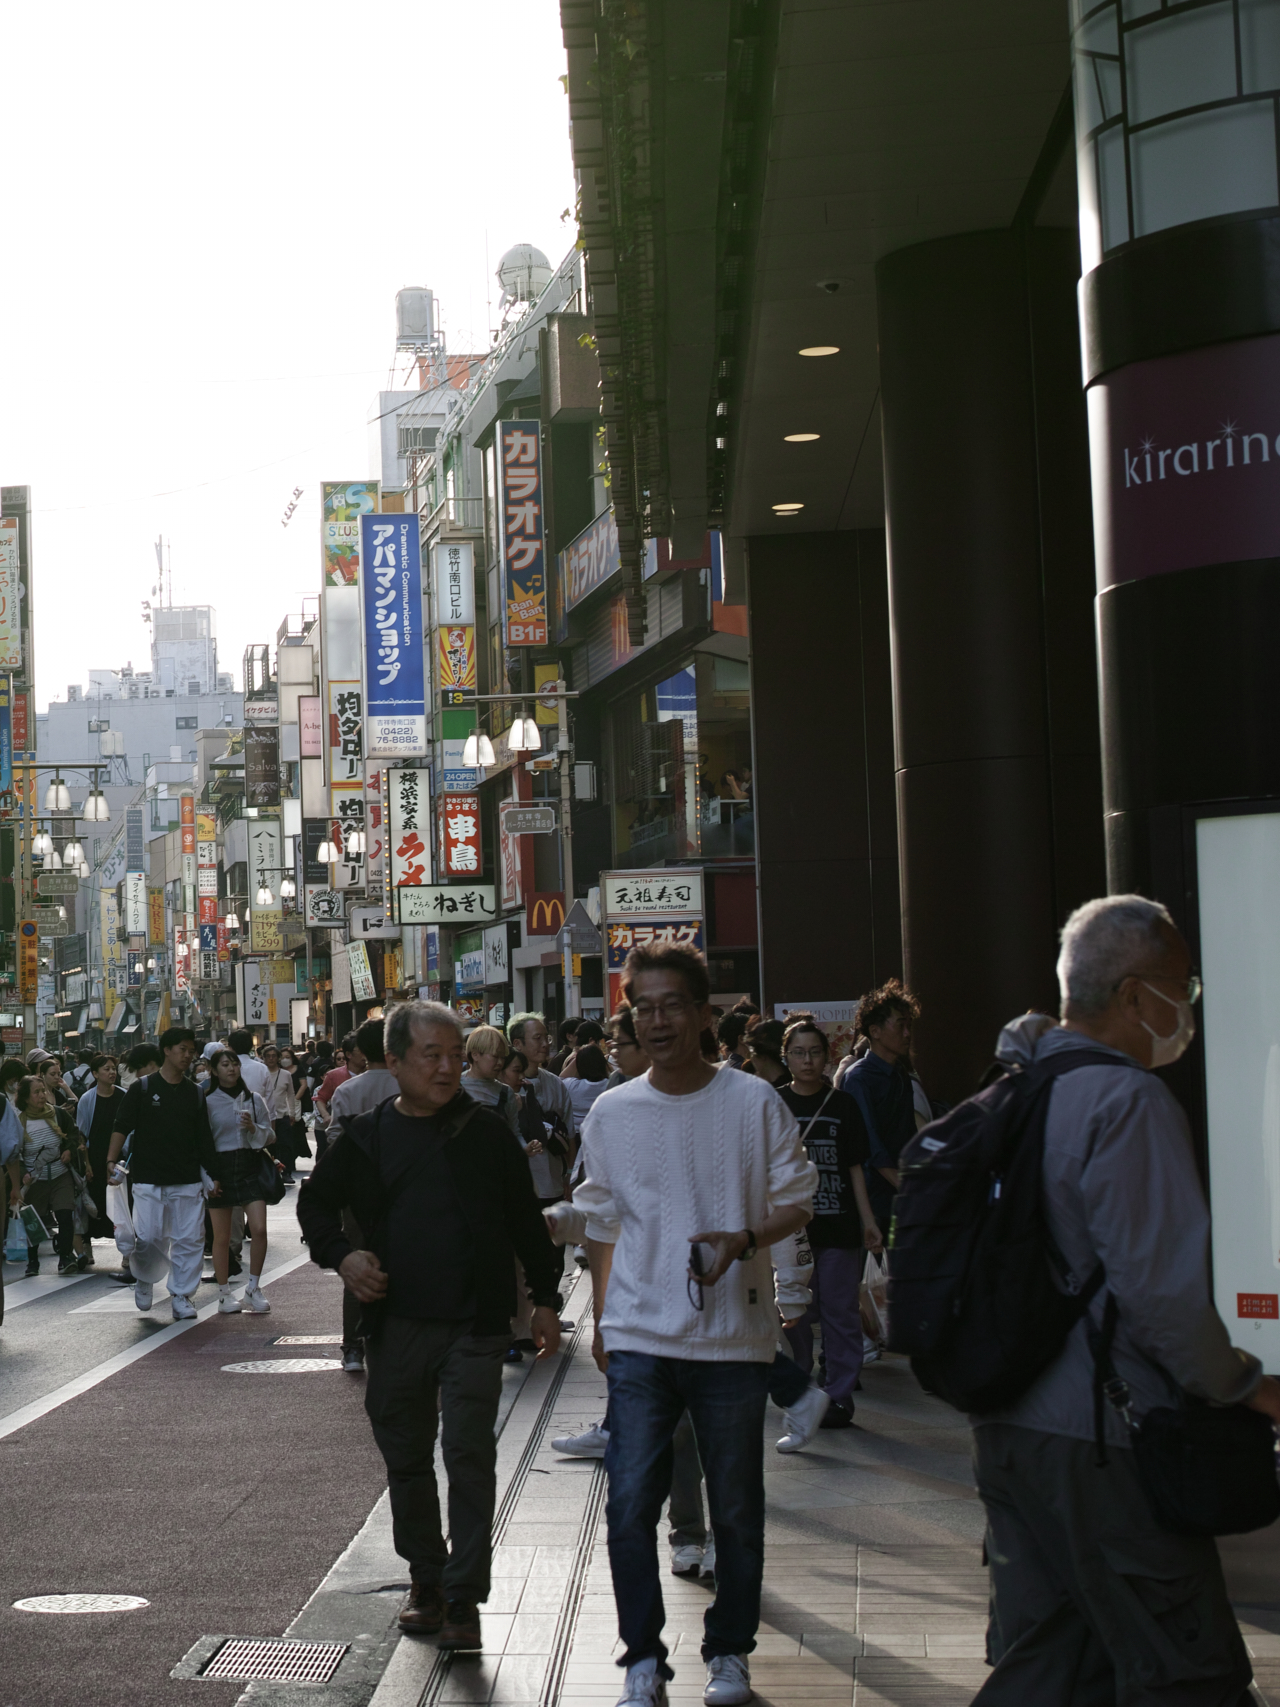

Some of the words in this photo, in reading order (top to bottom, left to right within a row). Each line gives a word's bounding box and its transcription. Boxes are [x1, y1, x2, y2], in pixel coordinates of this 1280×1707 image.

[1123, 420, 1280, 488] kirarin
[503, 429, 542, 571] カラオケ
[400, 523, 410, 569] Dramatic
[568, 521, 609, 599] カラオケ
[447, 547, 462, 620] 徳竹南口ビル
[372, 523, 401, 685] アパマンショップ
[401, 571, 412, 646] Communication
[509, 598, 534, 614] Ban
[519, 605, 543, 621] Ban
[510, 625, 545, 641] B1F
[0, 657, 18, 665] 入口
[245, 706, 278, 714] イケダビル
[380, 727, 414, 735] (0422)
[248, 759, 277, 771] Salva
[446, 782, 455, 790] 酒
[398, 771, 419, 831] 横浜家系
[516, 812, 542, 821] 吉祥寺
[506, 819, 553, 829] パークロード商店会
[447, 813, 479, 872] 串鳥
[402, 893, 423, 901] 牛たん
[614, 885, 692, 904] 元祖寿司
[433, 890, 496, 917] ねぎし
[619, 904, 634, 912] Sushi
[642, 903, 657, 911] round
[658, 903, 688, 911] restaurant
[151, 895, 161, 939] FOREST
[255, 912, 279, 920] ハイボール
[408, 909, 426, 918] 麦めし
[255, 931, 279, 939] 生ビール
[611, 924, 699, 950] カラオケ
[829, 1125, 837, 1137] 6
[1242, 1298, 1273, 1306] atman
[1242, 1305, 1273, 1314] atman
[1254, 1321, 1262, 1331] 5F
